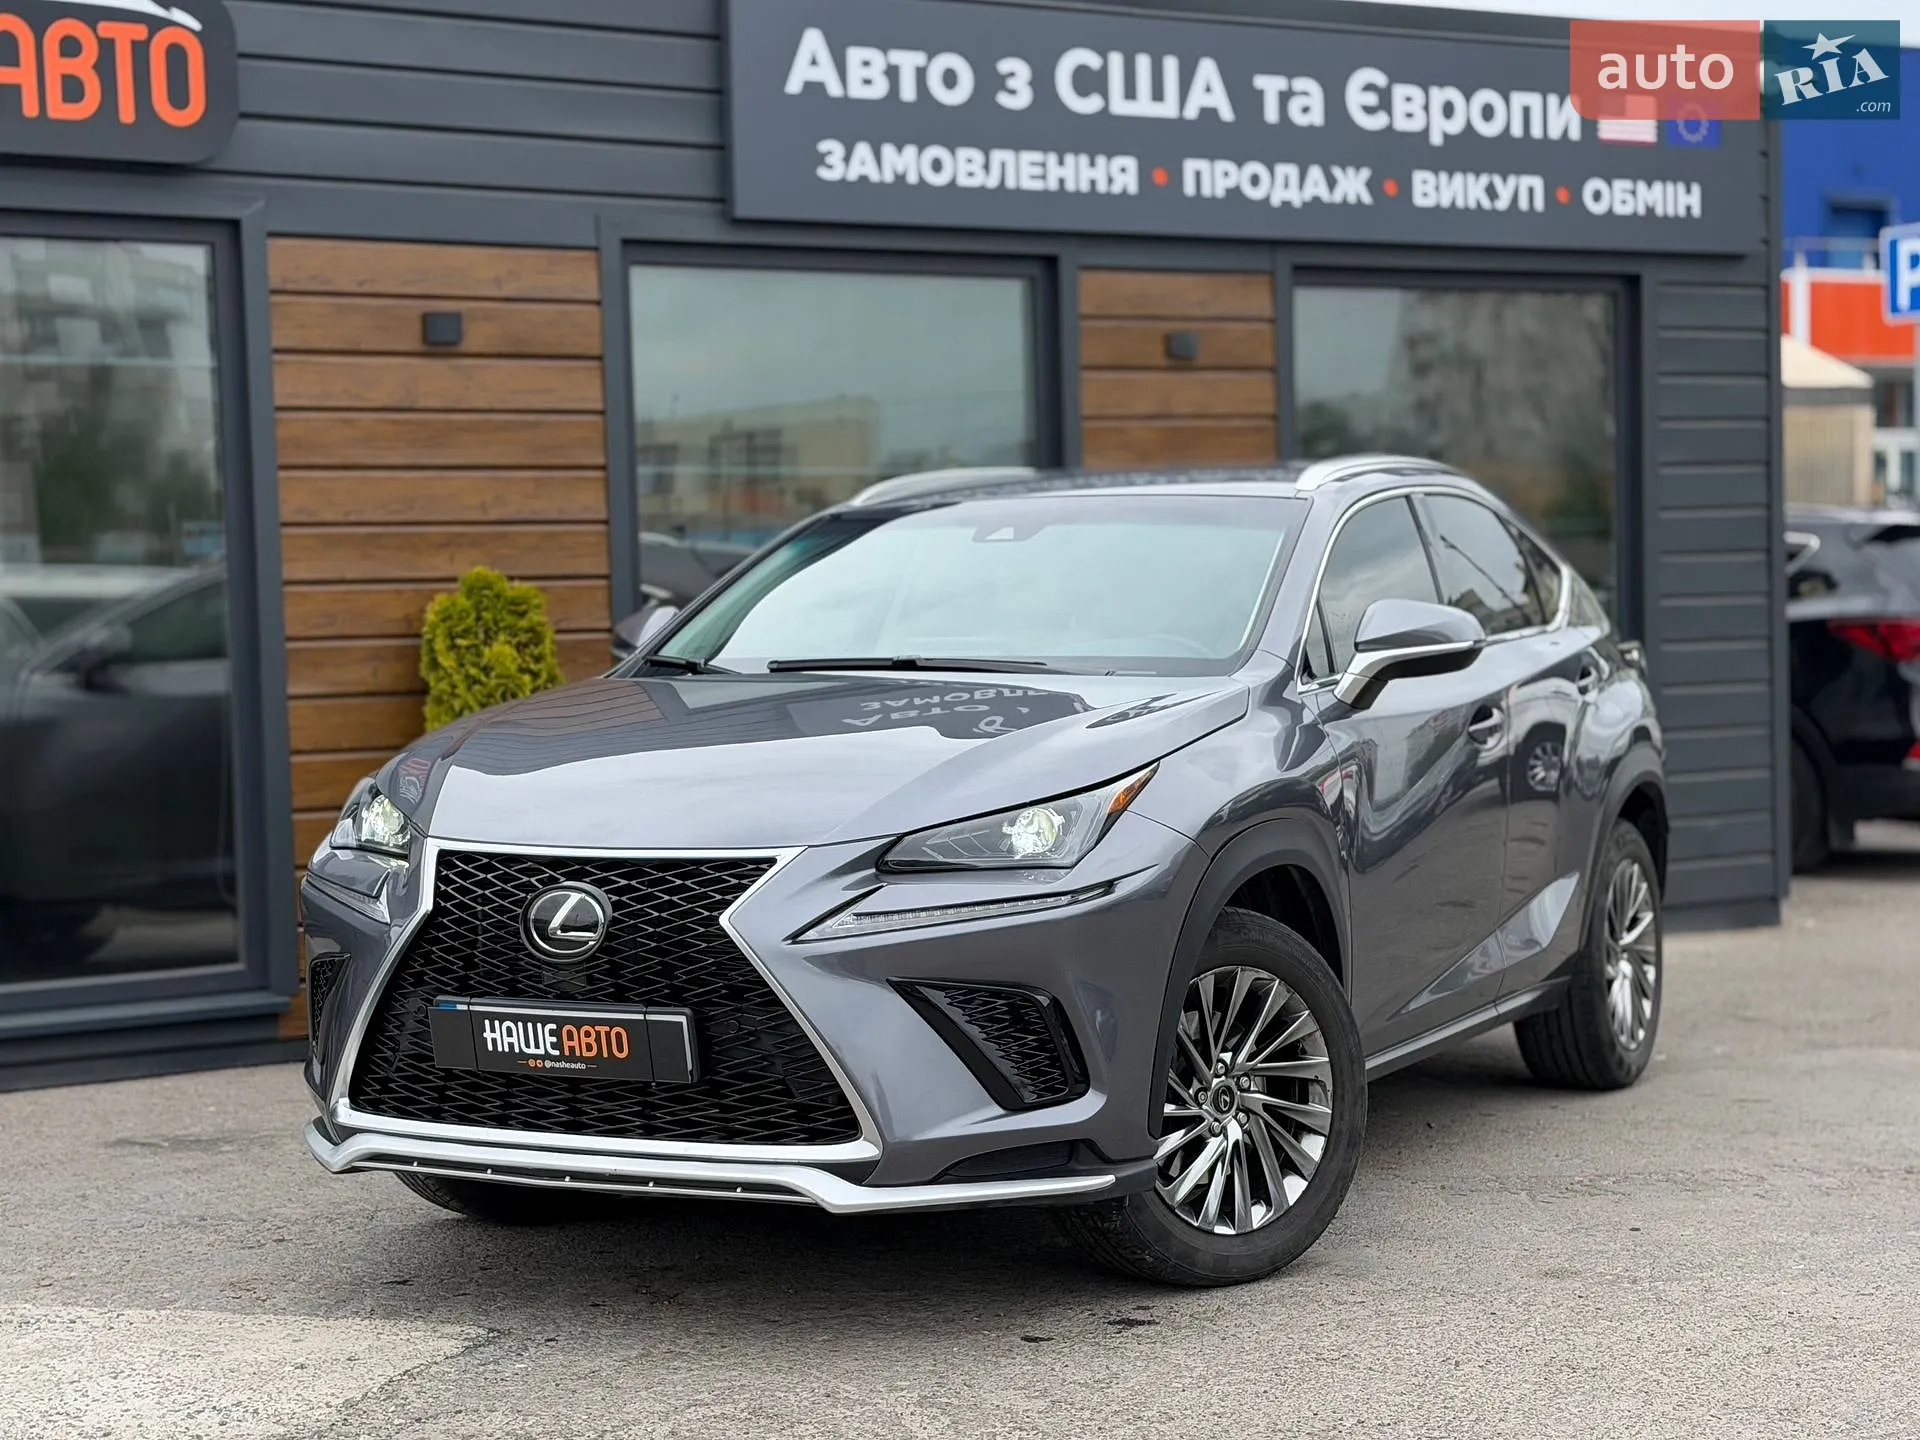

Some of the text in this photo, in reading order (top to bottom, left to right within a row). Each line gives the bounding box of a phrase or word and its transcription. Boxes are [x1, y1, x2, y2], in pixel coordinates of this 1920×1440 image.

[783, 27, 1582, 147] Авто з США та Європи
[815, 138, 1702, 218] ЗАМОВЛЕННЯ ПРОДАЖ ВИКУП ОБМІН
[483, 1019, 629, 1059] НАШЕ АВТО
